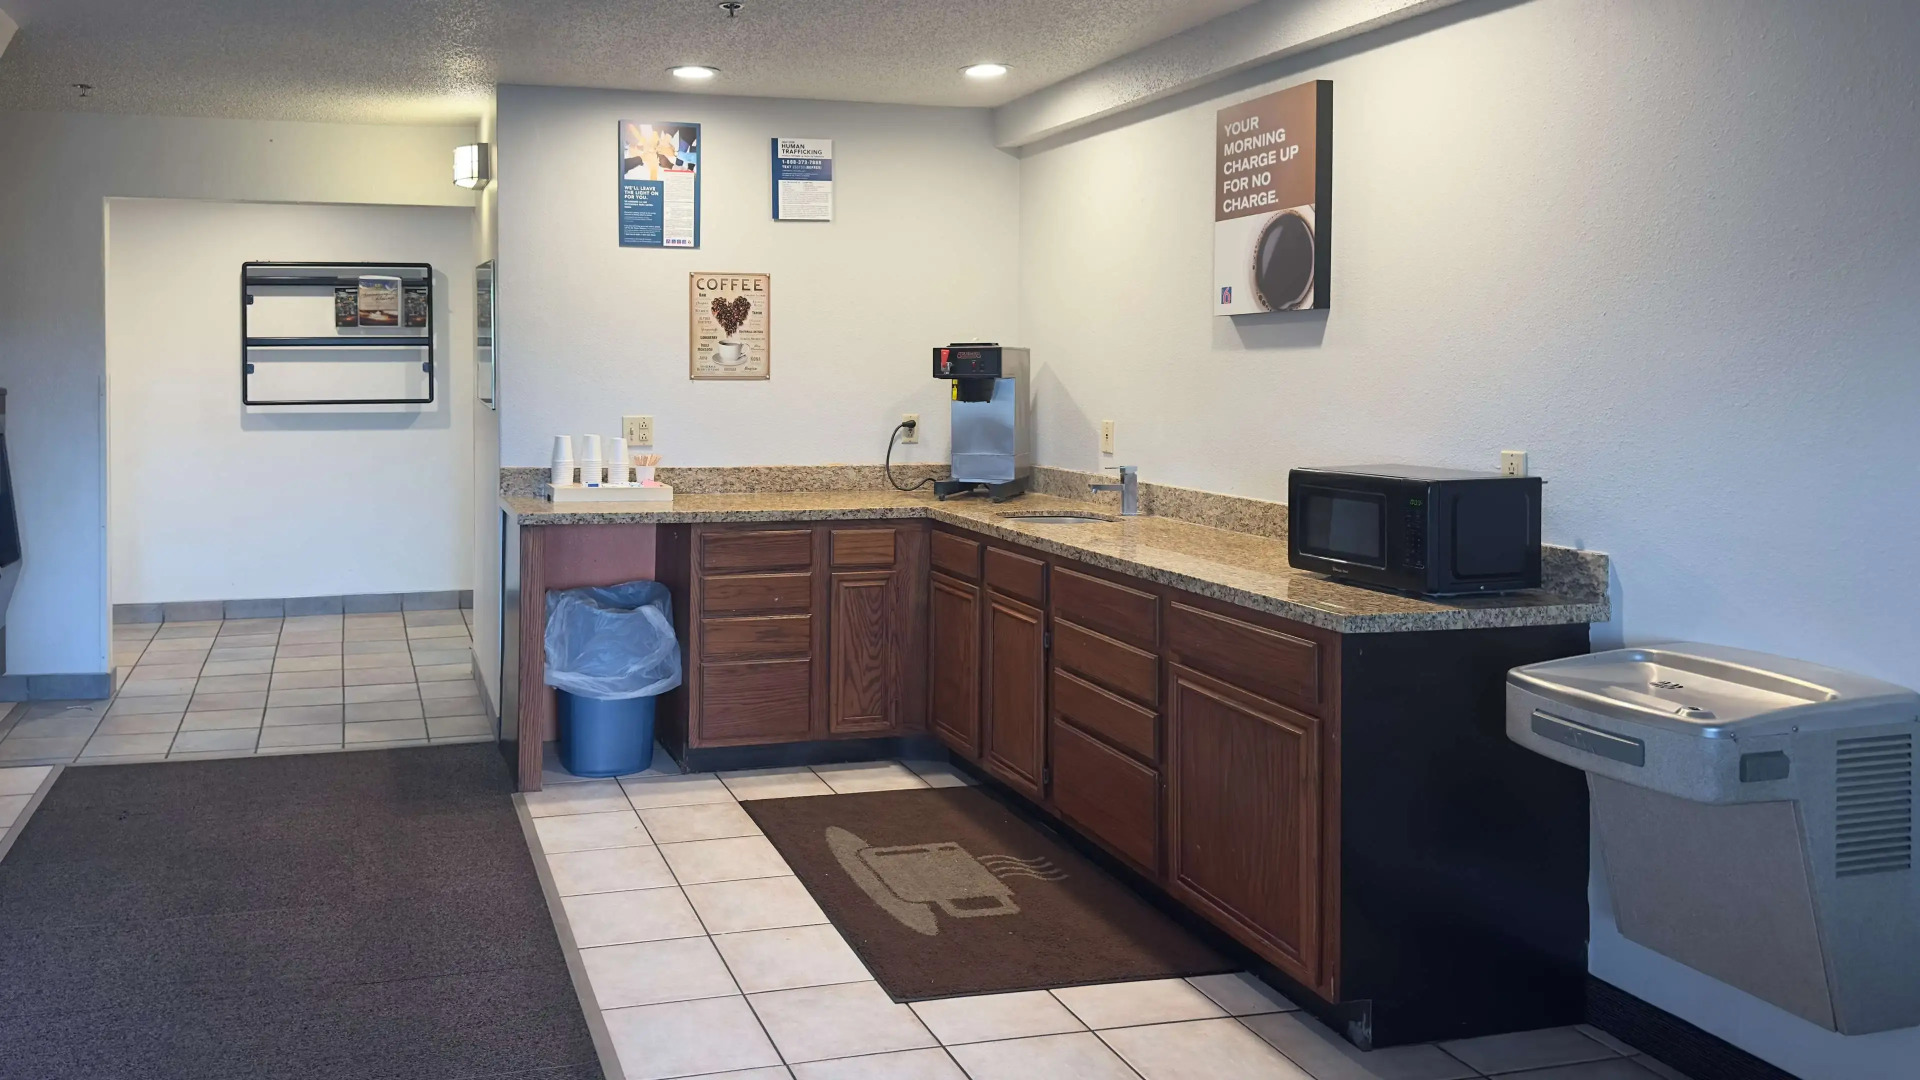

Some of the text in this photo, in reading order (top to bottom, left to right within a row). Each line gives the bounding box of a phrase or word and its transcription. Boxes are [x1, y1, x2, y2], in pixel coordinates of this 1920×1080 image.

[1224, 116, 1259, 137] YOUR
[1223, 128, 1286, 156] MORNING
[1223, 145, 1299, 175] CHARGE UP
[1223, 171, 1271, 194] FOR NO
[1223, 190, 1279, 213] CHARGE.
[696, 278, 763, 291] COFFEE
